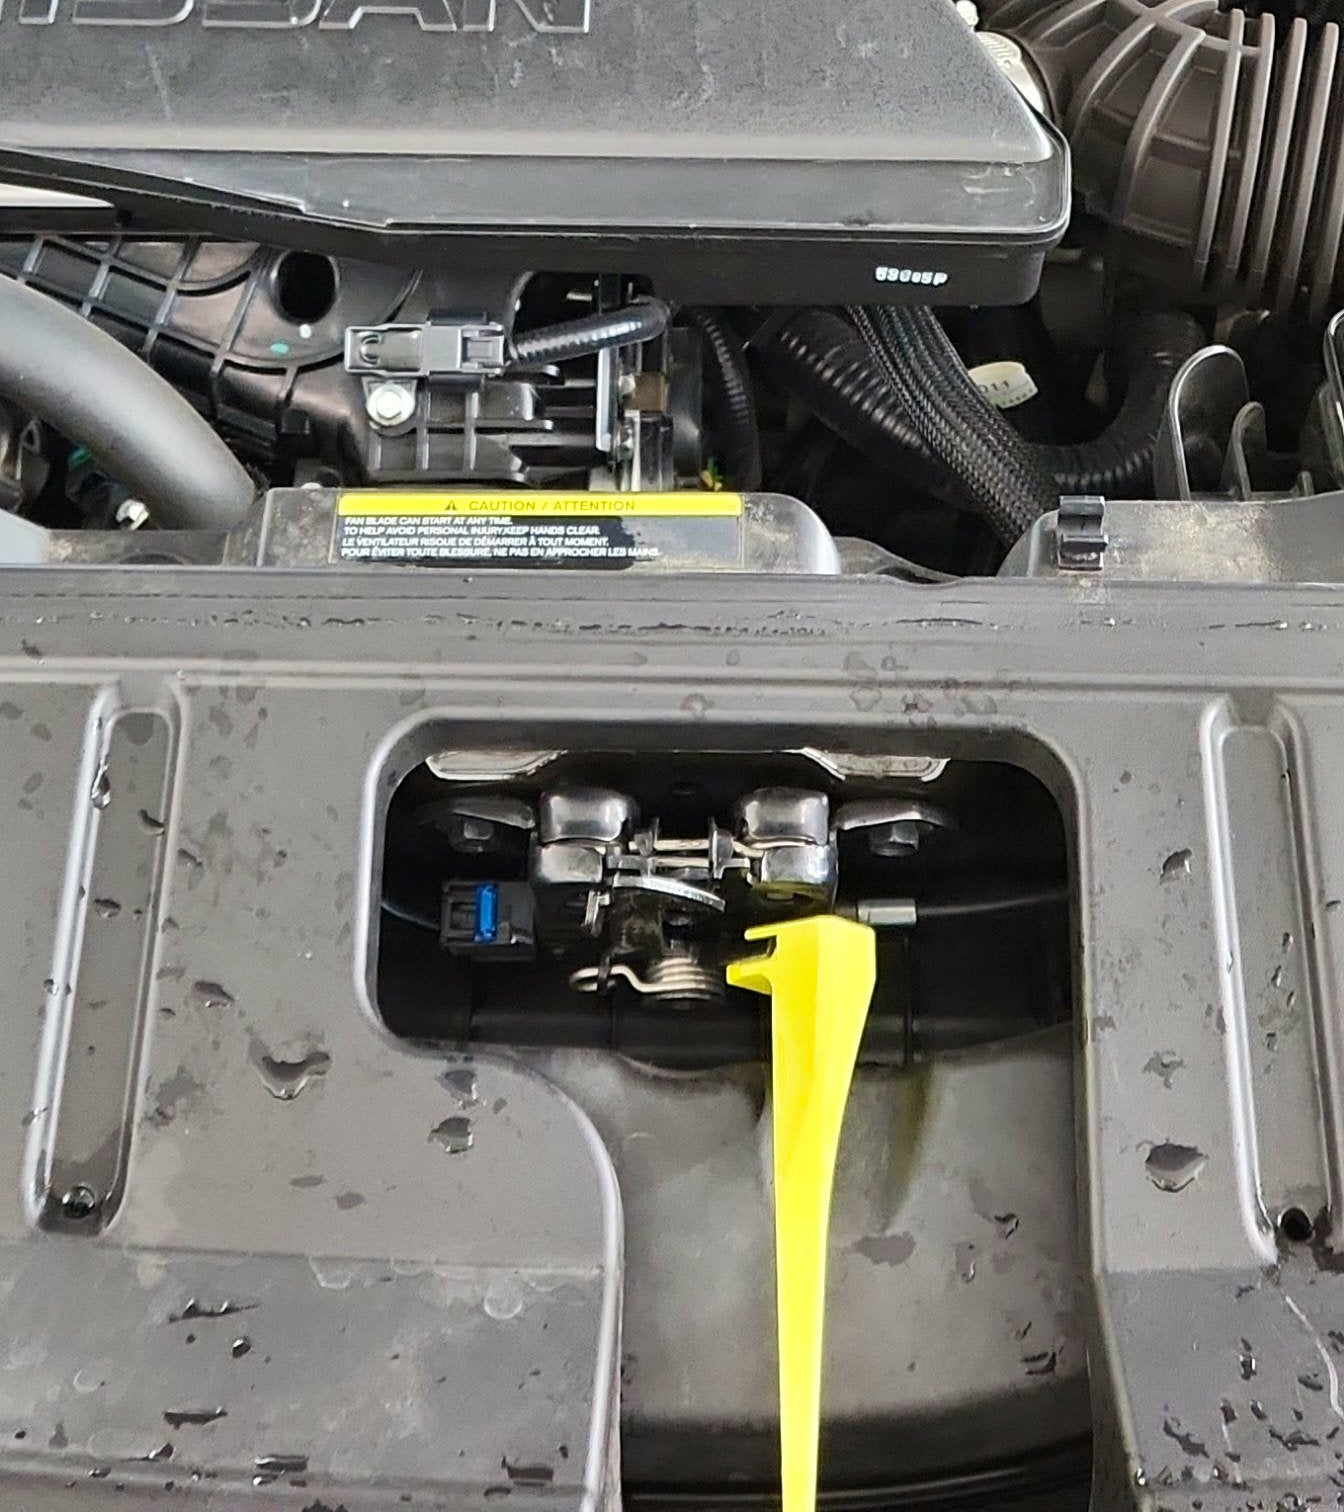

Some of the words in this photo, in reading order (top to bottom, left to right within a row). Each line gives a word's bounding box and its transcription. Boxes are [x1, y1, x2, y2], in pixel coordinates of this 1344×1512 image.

[468, 500, 536, 511] CAUTION
[553, 500, 636, 511] ATTENTION
[344, 517, 367, 525] FAN
[367, 517, 398, 525] BLADE
[399, 517, 421, 525] CAN
[422, 517, 455, 525] START
[455, 517, 468, 525] AT
[467, 517, 488, 525] ANY
[488, 517, 514, 525] TIME.
[344, 526, 358, 535] TO
[359, 526, 385, 535] HELP
[386, 526, 416, 535] AVOID
[417, 526, 470, 535] PERSONAL
[530, 526, 565, 535] HANDS
[566, 526, 601, 535] CLEAR.
[342, 537, 356, 546] LE
[356, 537, 419, 546] VENTILATEUR
[420, 537, 457, 546] RISQUE
[458, 537, 472, 546] DE
[473, 535, 526, 546] DÉMARRER
[528, 535, 536, 546] À
[537, 537, 564, 546] TOUT
[565, 537, 609, 546] MOMENT.
[341, 548, 371, 557] POUR
[372, 546, 405, 557] ÉVITER
[407, 548, 437, 557] TOUTE
[493, 548, 508, 557] NE
[509, 548, 528, 557] PAS
[530, 548, 545, 557] EN
[545, 548, 606, 557] APPROCHER
[608, 548, 627, 557] LES
[628, 548, 661, 557] MAINS.
